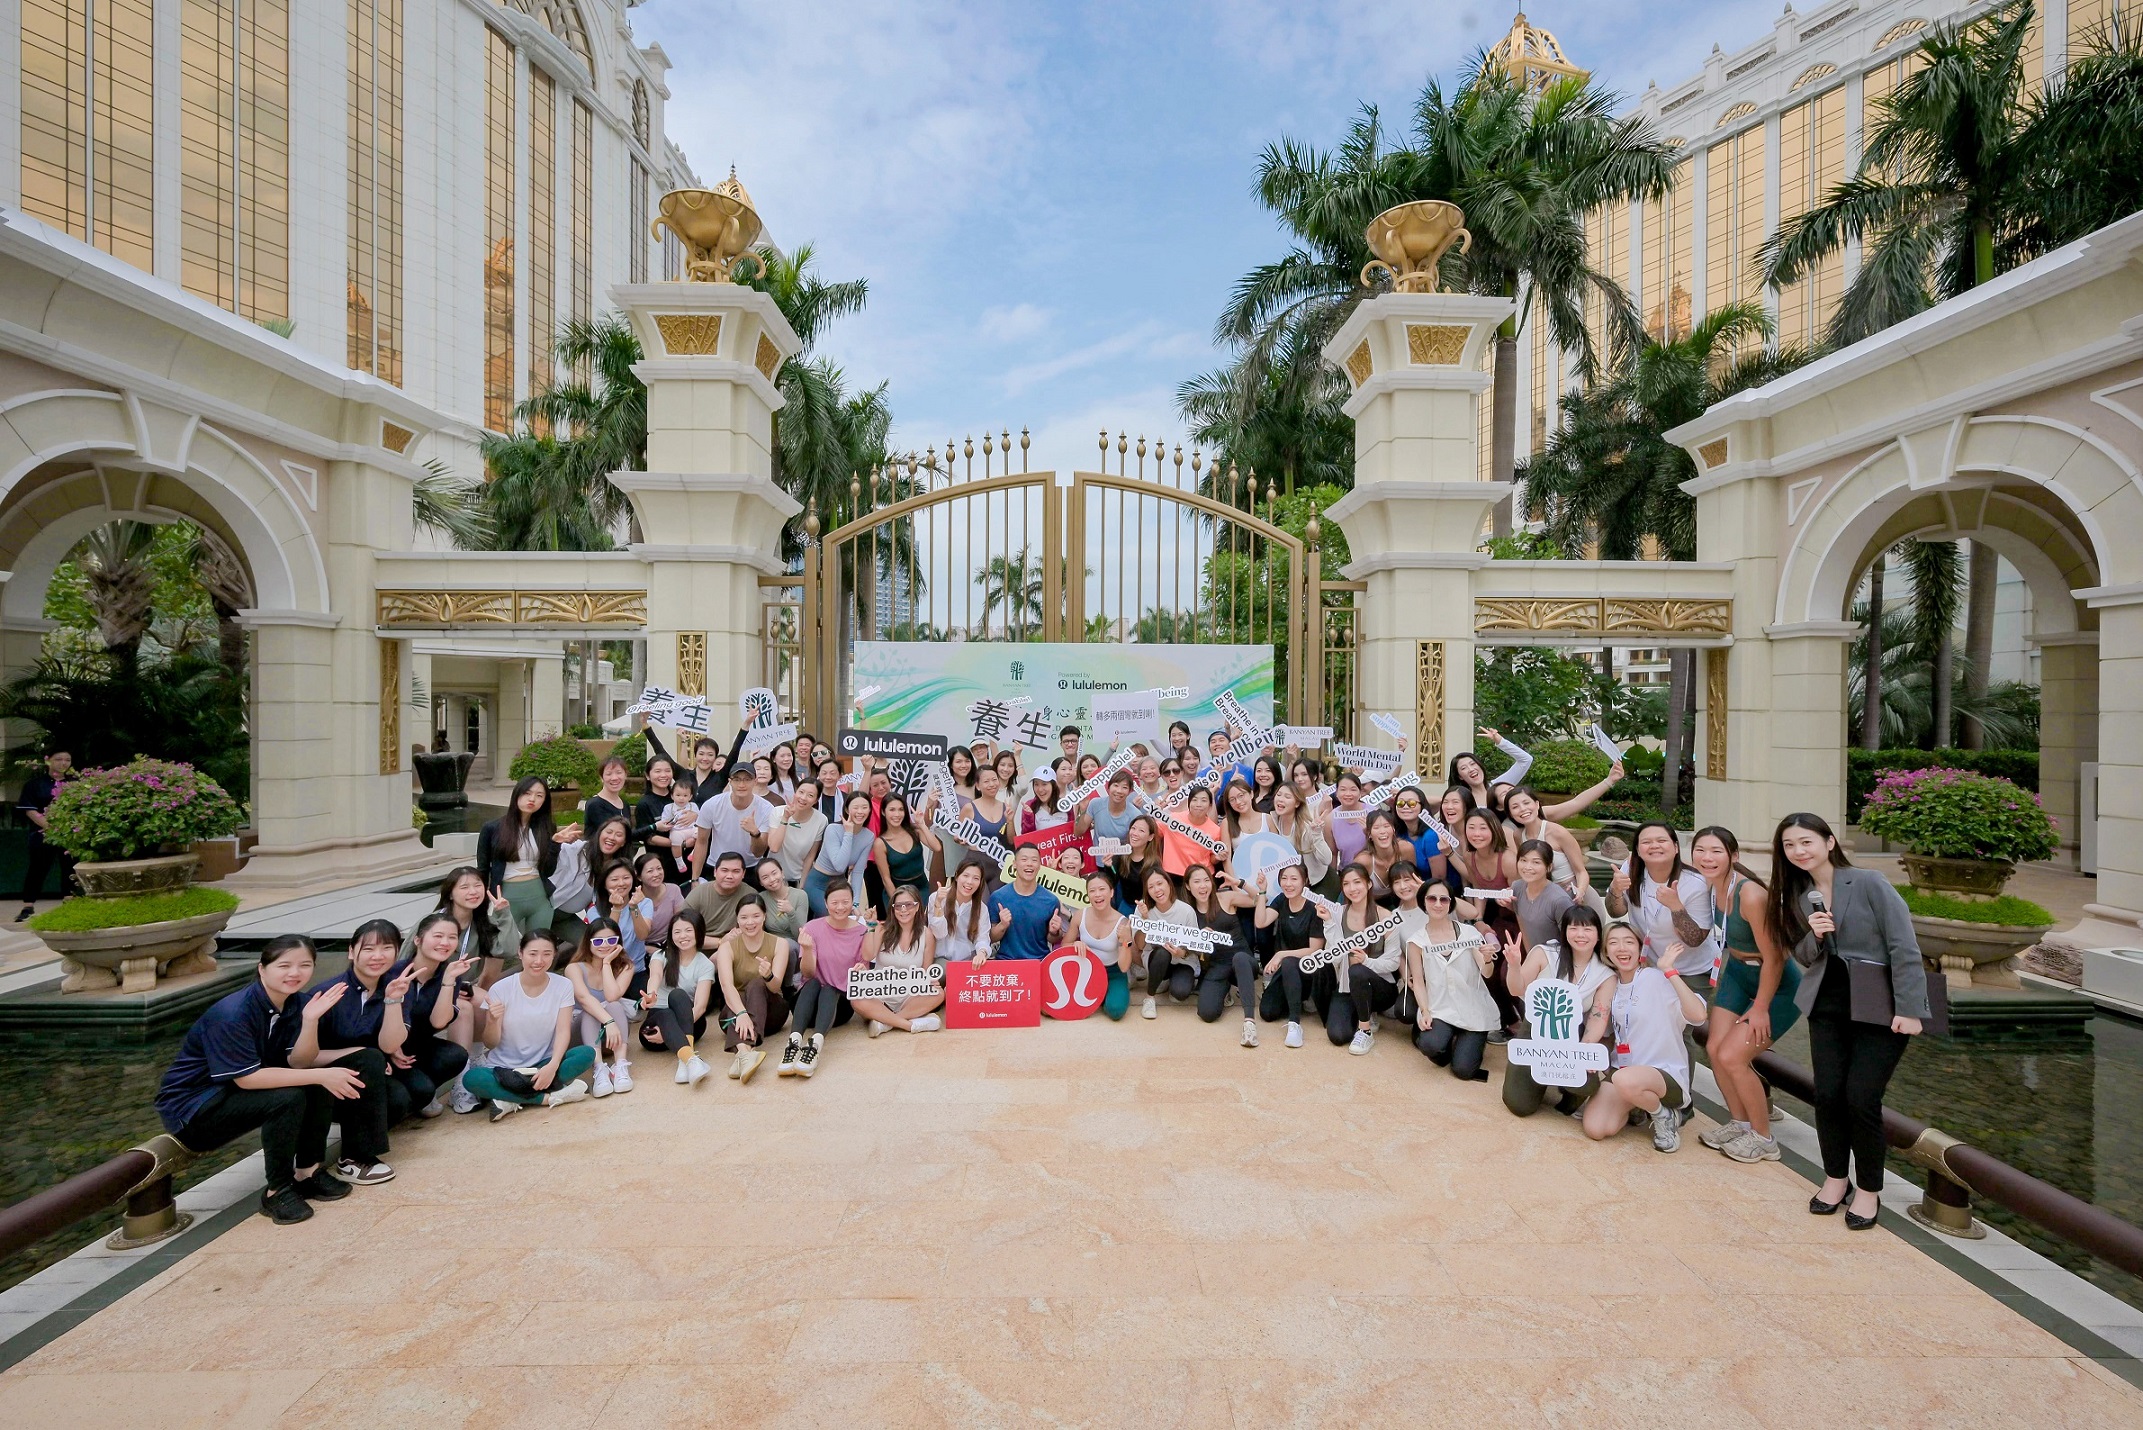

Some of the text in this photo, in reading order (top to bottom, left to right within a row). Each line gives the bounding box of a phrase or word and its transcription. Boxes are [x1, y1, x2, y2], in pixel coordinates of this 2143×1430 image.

[1072, 680, 1127, 690] lululemon
[637, 697, 704, 712] Feeling good
[1223, 691, 1252, 726] Breathe
[1214, 698, 1244, 732] Breathe
[970, 699, 1052, 750] 養生
[1372, 714, 1405, 738] supporte
[744, 734, 773, 745] ANYAN
[864, 737, 942, 755] lululemon
[1337, 747, 1402, 762] World Mental
[1342, 757, 1393, 772] Health Day
[939, 761, 955, 797] ogether
[1068, 749, 1135, 802] Unstoppable!
[1169, 788, 1188, 805] got
[1321, 785, 1337, 795] brav
[1169, 820, 1191, 836] got
[1192, 830, 1213, 848] this
[1090, 844, 1130, 853] confident
[1275, 856, 1301, 869] worthy
[1131, 917, 1232, 944] Together we grow.
[1314, 913, 1404, 967] Feeling good
[1448, 939, 1481, 952] strong
[850, 968, 927, 983] Breathe in,
[966, 974, 1025, 988] 不要放棄，
[849, 983, 938, 998] Breathe out.
[959, 989, 1031, 1003] 終點就到了！
[1516, 1047, 1600, 1061] BANYAN TREE
[1540, 1061, 1576, 1069] MACAU
